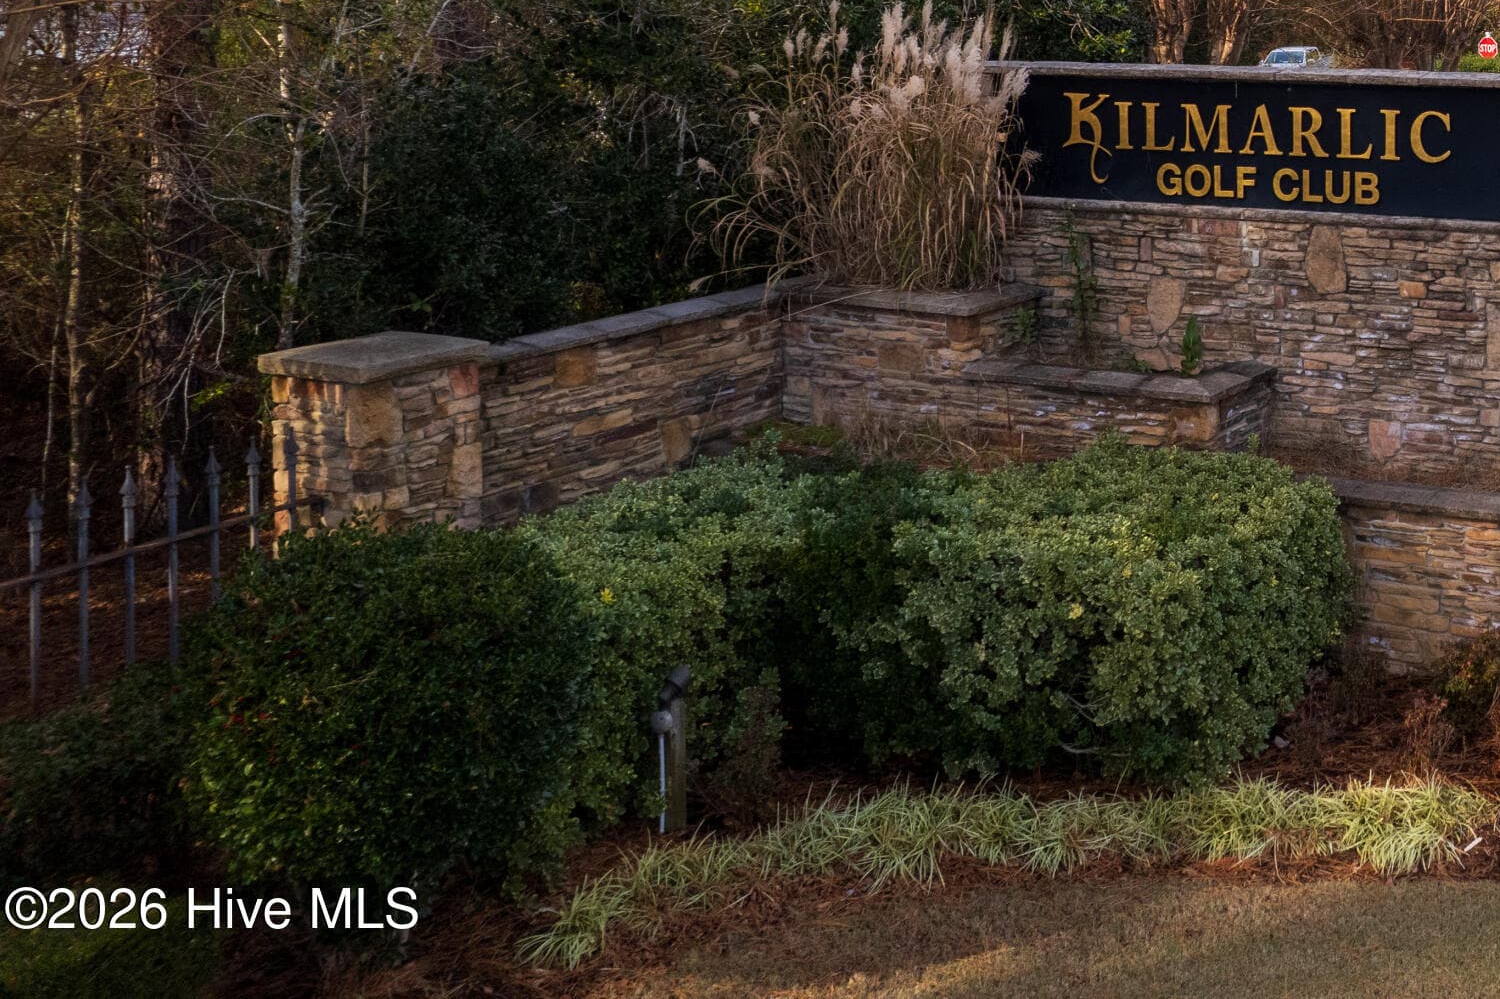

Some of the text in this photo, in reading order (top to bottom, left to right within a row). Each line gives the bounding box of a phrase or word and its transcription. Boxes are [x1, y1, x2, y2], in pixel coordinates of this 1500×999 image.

[1480, 44, 1496, 53] STOP
[1062, 91, 1453, 185] KILMARLIC
[1156, 162, 1381, 206] GOLF CLUB
